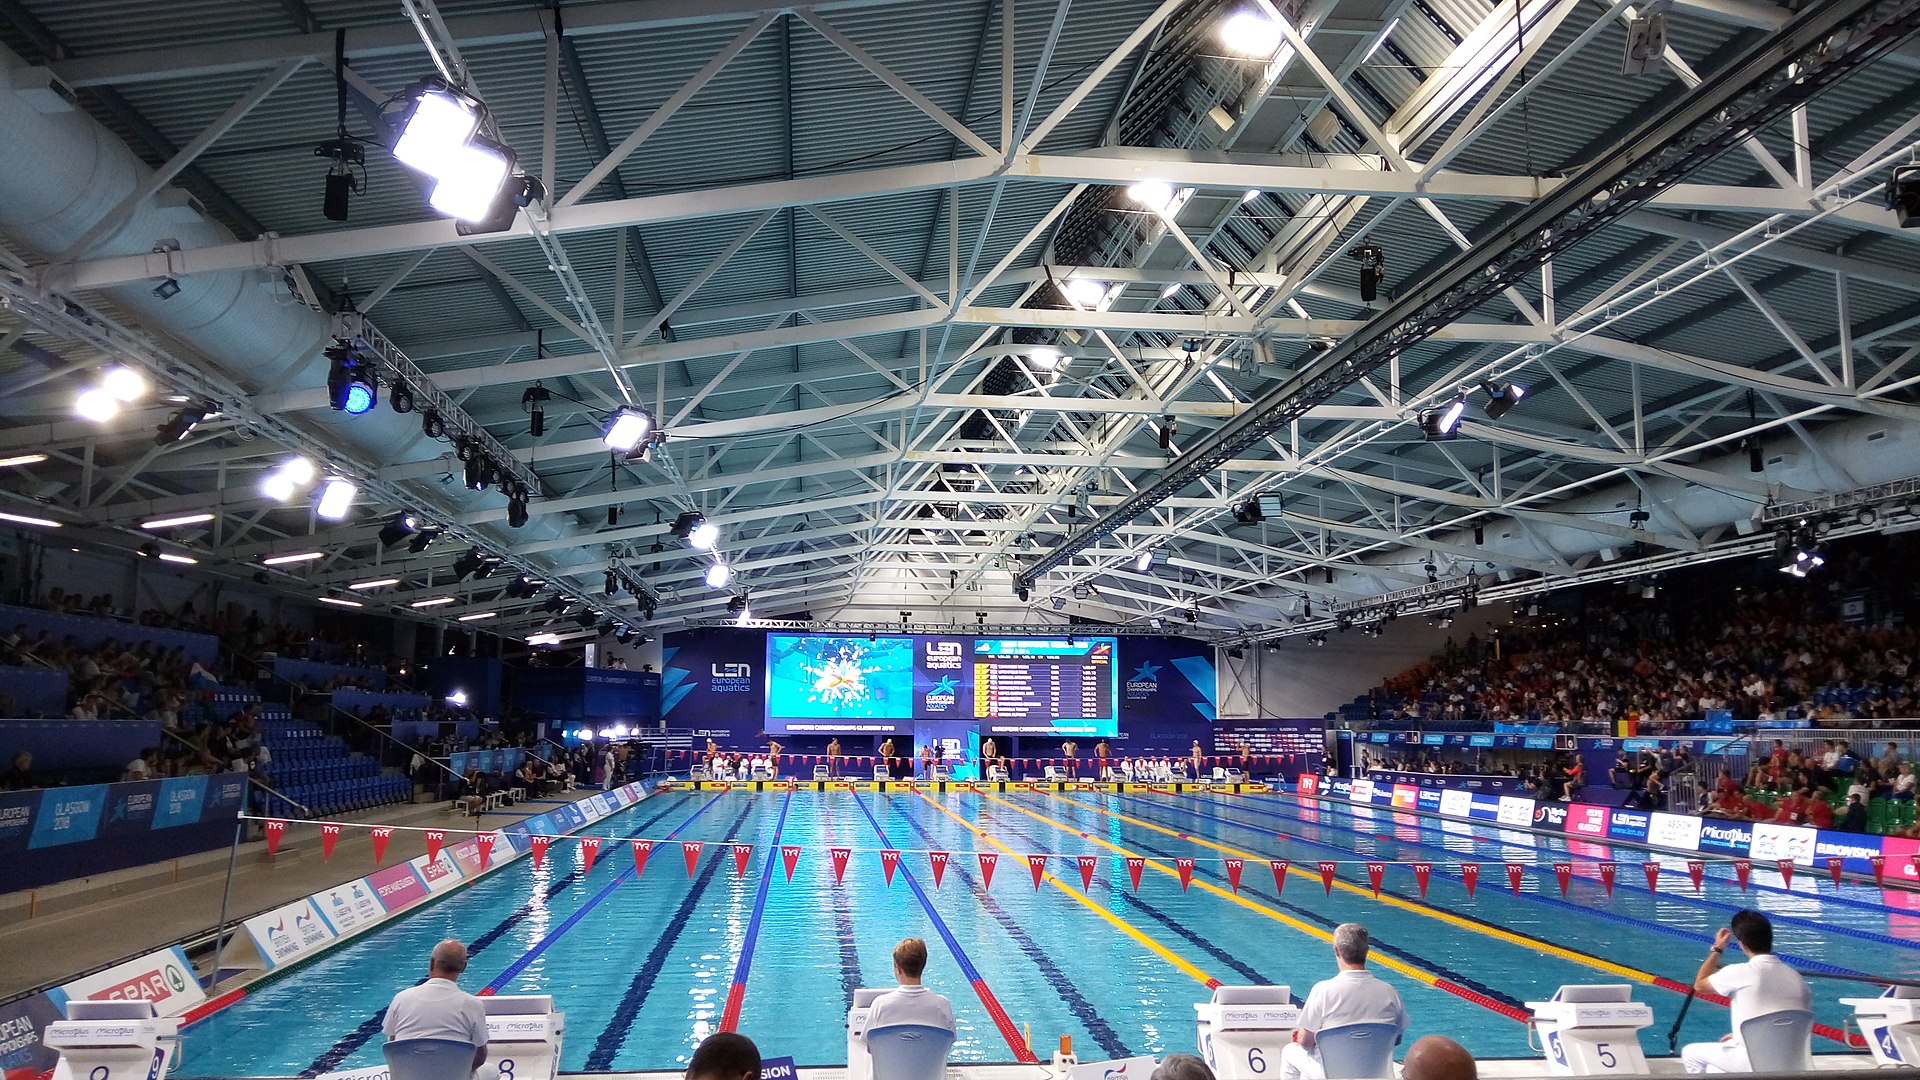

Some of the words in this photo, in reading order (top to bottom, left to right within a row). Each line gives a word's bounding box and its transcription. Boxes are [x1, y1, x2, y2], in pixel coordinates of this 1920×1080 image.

[926, 641, 962, 655] LEN
[712, 663, 750, 678] LEN
[926, 662, 962, 670] aquatics
[711, 685, 750, 693] aquatics
[55, 801, 90, 816] GLASGOW
[53, 816, 70, 830] 2018
[1612, 813, 1629, 824] LEN
[268, 822, 283, 830] TYR
[324, 826, 338, 834] TYR
[374, 829, 390, 838] TYR
[428, 832, 443, 840] TYR
[1612, 828, 1645, 836] www.len.eu
[479, 836, 494, 844] TYR
[532, 836, 548, 844] TYR
[584, 840, 598, 848] TYR
[635, 842, 650, 851] TYR
[684, 843, 700, 852] TYR
[736, 846, 750, 854] TYR
[1816, 842, 1880, 859] EUROVISION
[784, 849, 798, 857] TYR
[834, 850, 848, 858] TYR
[884, 852, 898, 861] TYR
[932, 854, 946, 862] TYR
[980, 856, 996, 864] TYR
[1080, 858, 1094, 867] TYR
[1128, 859, 1144, 867] TYR
[1178, 859, 1192, 867] TYR
[1227, 860, 1242, 868] TYR
[1272, 862, 1286, 870] TYR
[426, 862, 446, 879] SPAR
[1320, 864, 1334, 872] TYR
[1369, 864, 1384, 872] TYR
[1416, 865, 1430, 873] TYR
[1464, 865, 1478, 874] TYR
[1508, 865, 1522, 874] TYR
[1556, 865, 1572, 874] TYR
[1601, 865, 1616, 874] TYR
[1645, 864, 1660, 872] TYR
[1688, 864, 1704, 872] TYR
[303, 930, 325, 946] SWIMMING
[276, 942, 300, 959] SWIMMING
[1553, 1038, 1562, 1059] 5
[1882, 1034, 1892, 1054] 4
[1248, 1047, 1266, 1074] 6
[1597, 1044, 1616, 1068] 5
[151, 1056, 159, 1080] 9
[498, 1058, 515, 1080] 8
